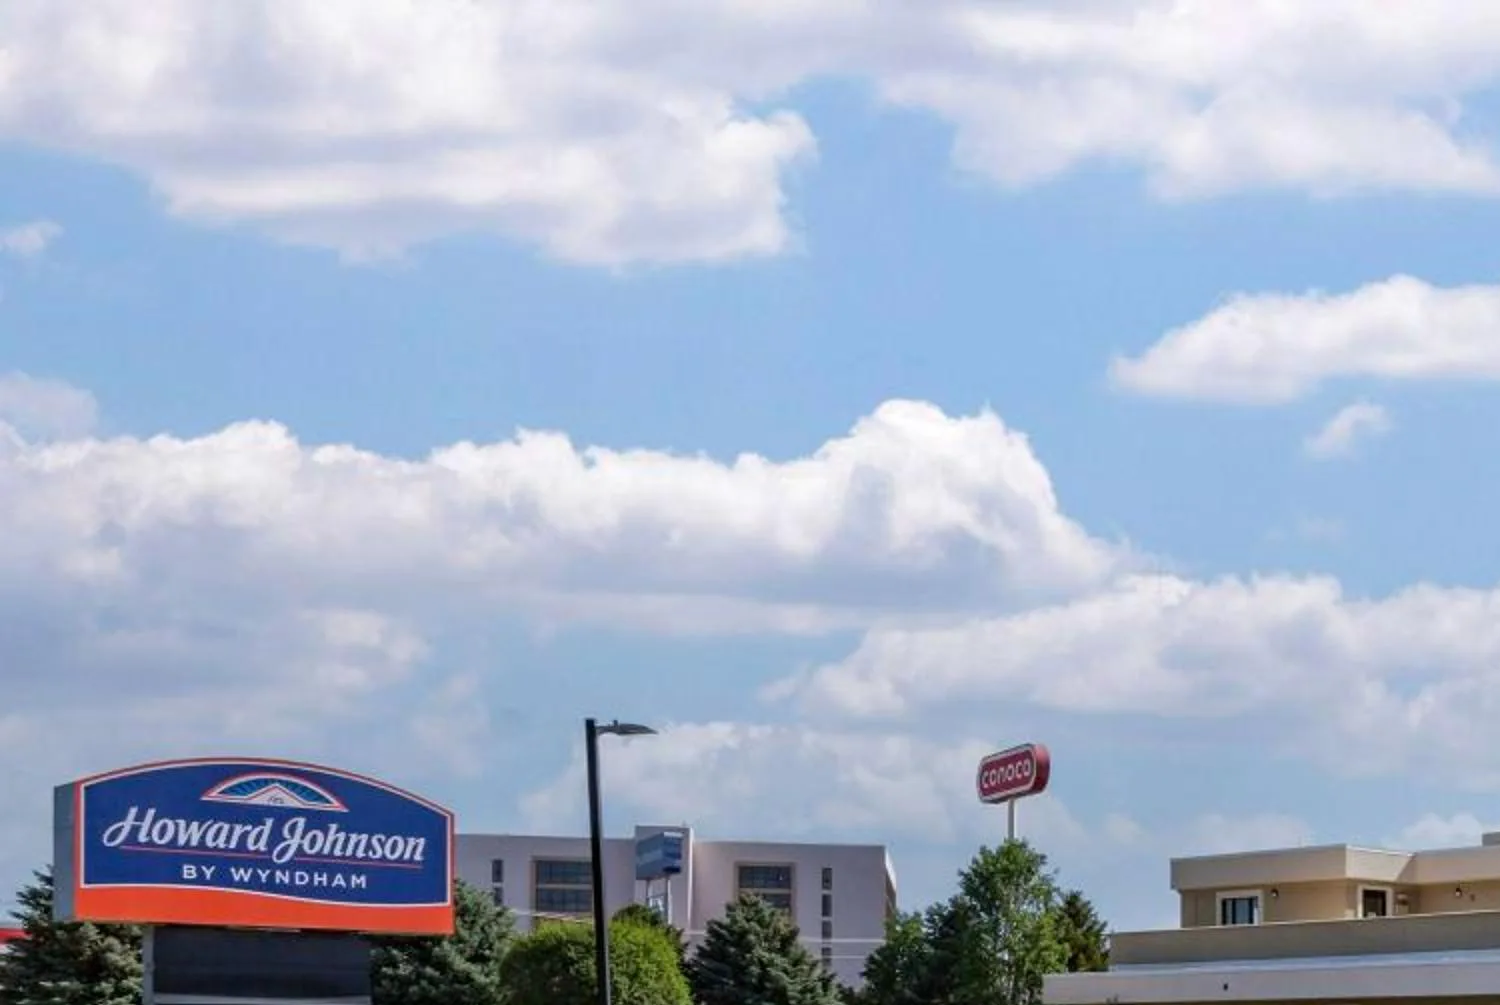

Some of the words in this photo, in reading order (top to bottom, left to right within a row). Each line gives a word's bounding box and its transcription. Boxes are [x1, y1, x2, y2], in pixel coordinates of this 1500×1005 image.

[103, 806, 271, 849] Howard
[272, 817, 426, 863] Johnson
[182, 864, 216, 880] BY
[229, 867, 368, 889] WYNDHAM
